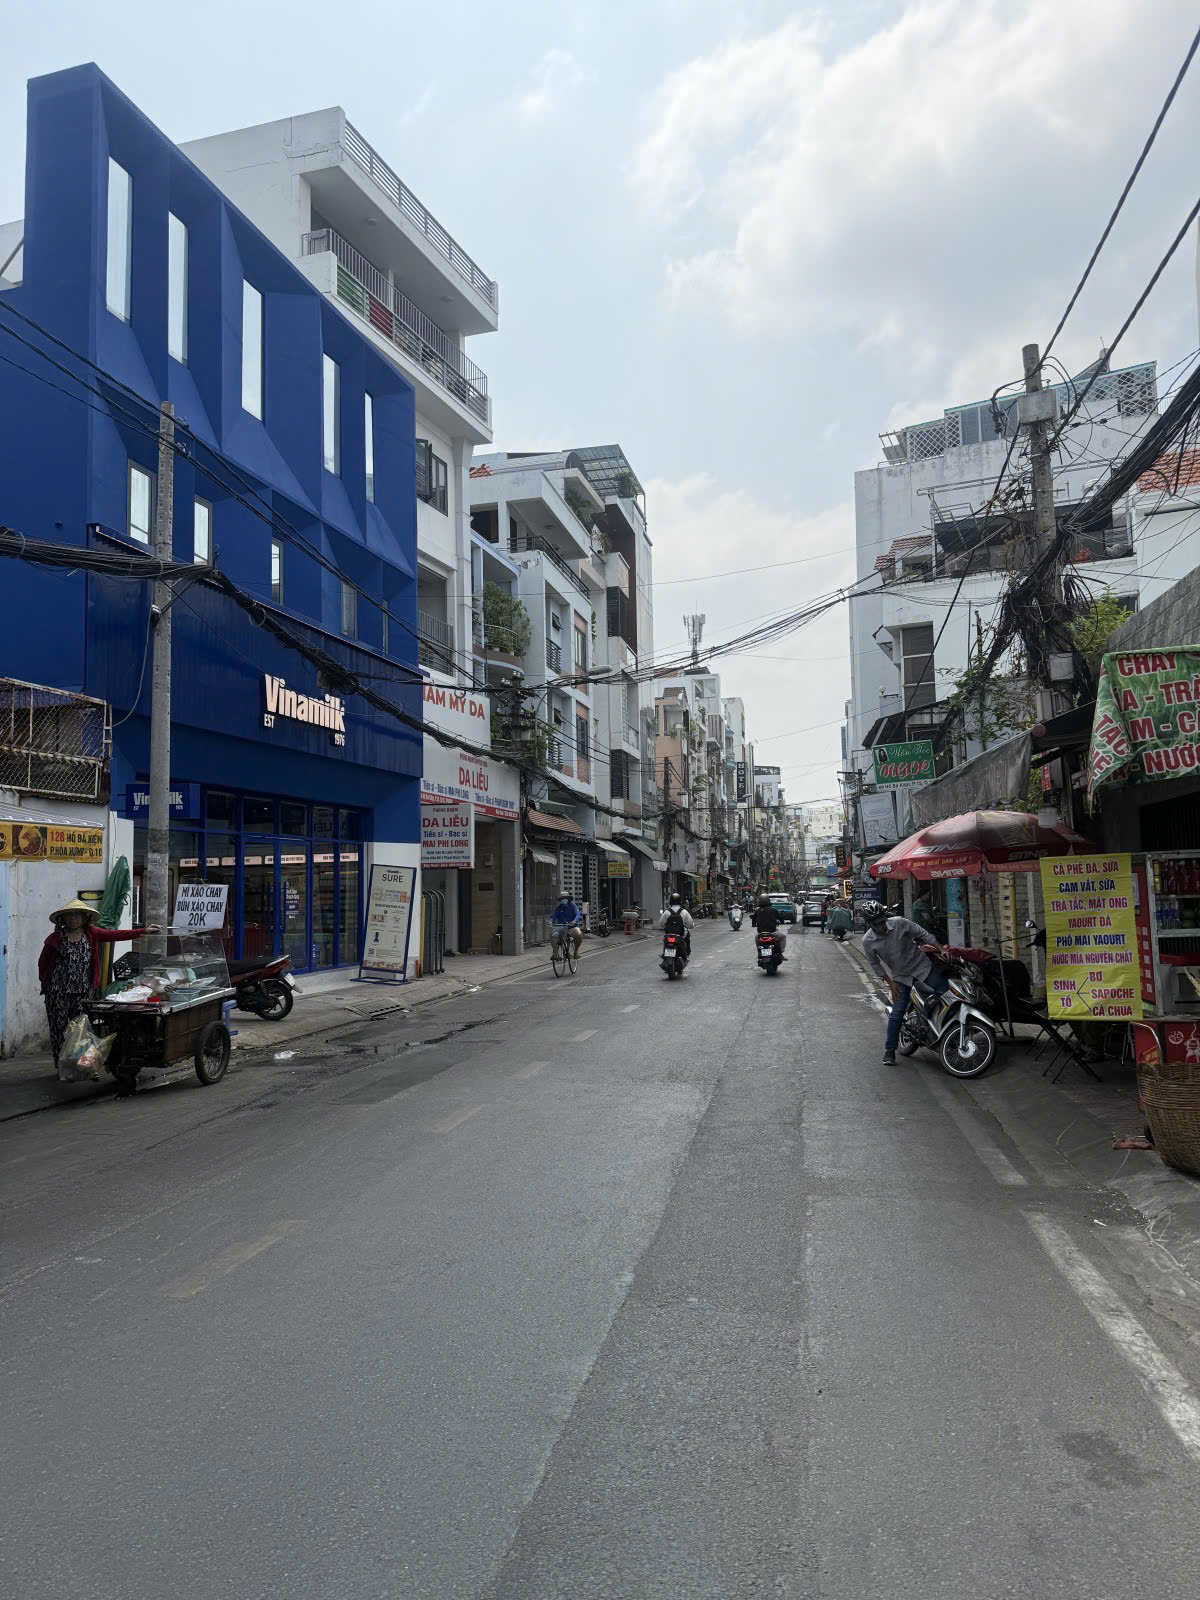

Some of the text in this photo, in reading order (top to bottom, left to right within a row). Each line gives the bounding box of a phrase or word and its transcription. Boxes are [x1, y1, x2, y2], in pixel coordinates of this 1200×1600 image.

[1117, 653, 1176, 677] CHAY
[265, 674, 345, 732] Vinamilk
[469, 700, 485, 720] DA
[264, 713, 275, 728] EST
[459, 767, 470, 787] DA
[422, 817, 439, 828] DA
[50, 831, 65, 842] 128
[422, 840, 435, 848] MAI
[451, 840, 468, 848] LONG
[88, 847, 102, 857] Q.10
[1067, 862, 1084, 875] PHÊ
[1103, 860, 1119, 872] SỮA
[382, 873, 404, 882] SURE
[1059, 882, 1078, 893] CAM
[1099, 878, 1116, 891] SỮA
[206, 887, 223, 897] CHAY
[206, 901, 224, 912] CHAY
[1051, 899, 1067, 912] TRÀ
[1109, 897, 1128, 908] ONG
[188, 912, 207, 926] 20K
[1068, 916, 1096, 928] YAOURT
[1056, 934, 1126, 947] PHÔ MAI YAOURT
[1085, 951, 1113, 964] NGUYÊN
[1089, 970, 1103, 982] BƠ
[1054, 980, 1076, 990] SINH
[1091, 988, 1134, 999] SAPOCHE
[1060, 994, 1072, 1007] TỐ
[1092, 1004, 1132, 1016] CÀ CHUA
